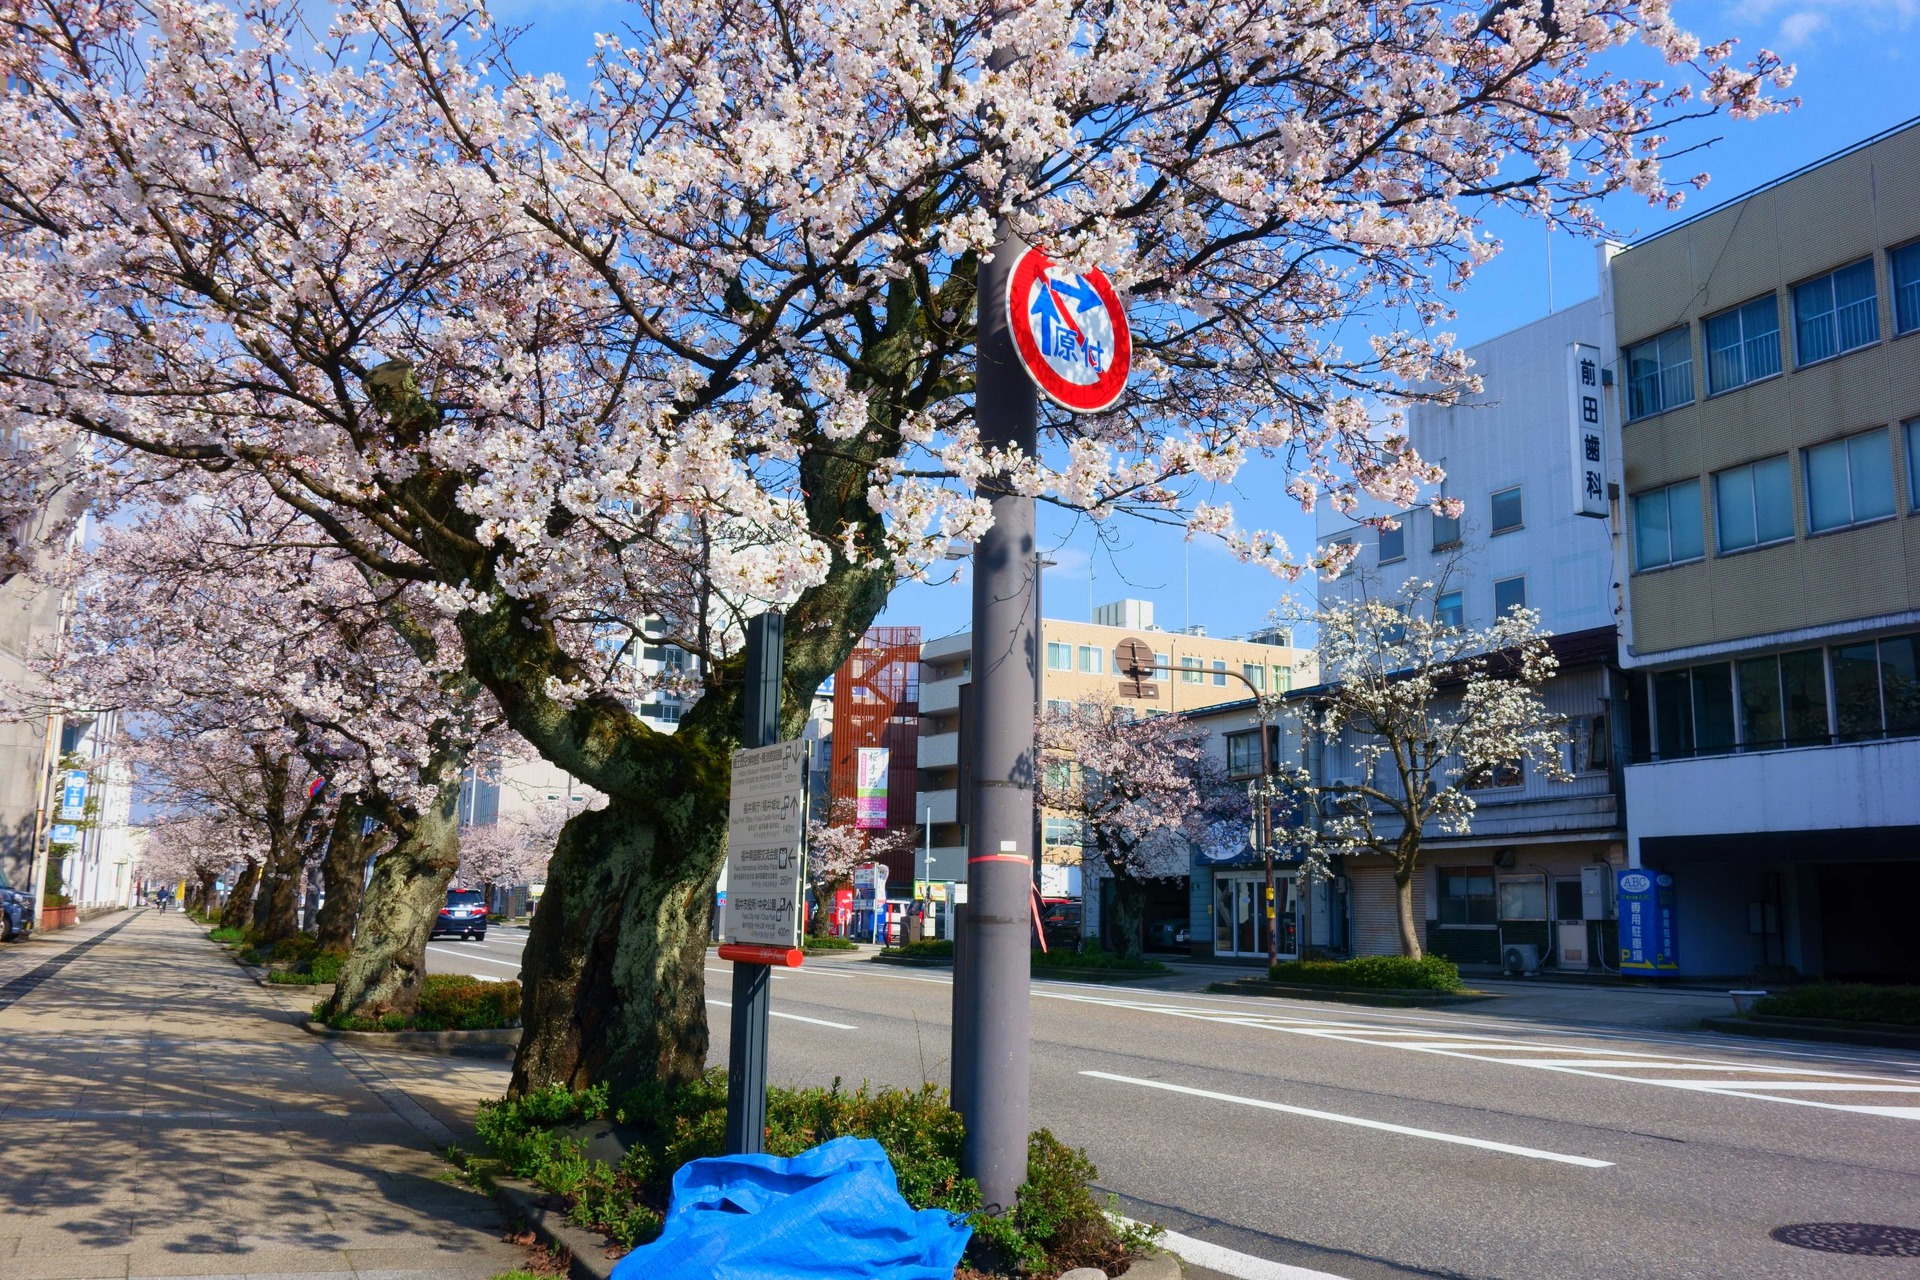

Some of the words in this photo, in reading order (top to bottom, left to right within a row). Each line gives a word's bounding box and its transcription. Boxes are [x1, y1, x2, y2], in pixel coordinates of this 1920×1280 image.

[1054, 325, 1104, 373] 原付
[1580, 358, 1602, 501] 前田歯科
[780, 875, 792, 885] 250m
[1624, 877, 1646, 888] ABC
[777, 927, 791, 937] 400m
[1631, 902, 1643, 962] 専用駐車場
[1622, 949, 1631, 961] P
